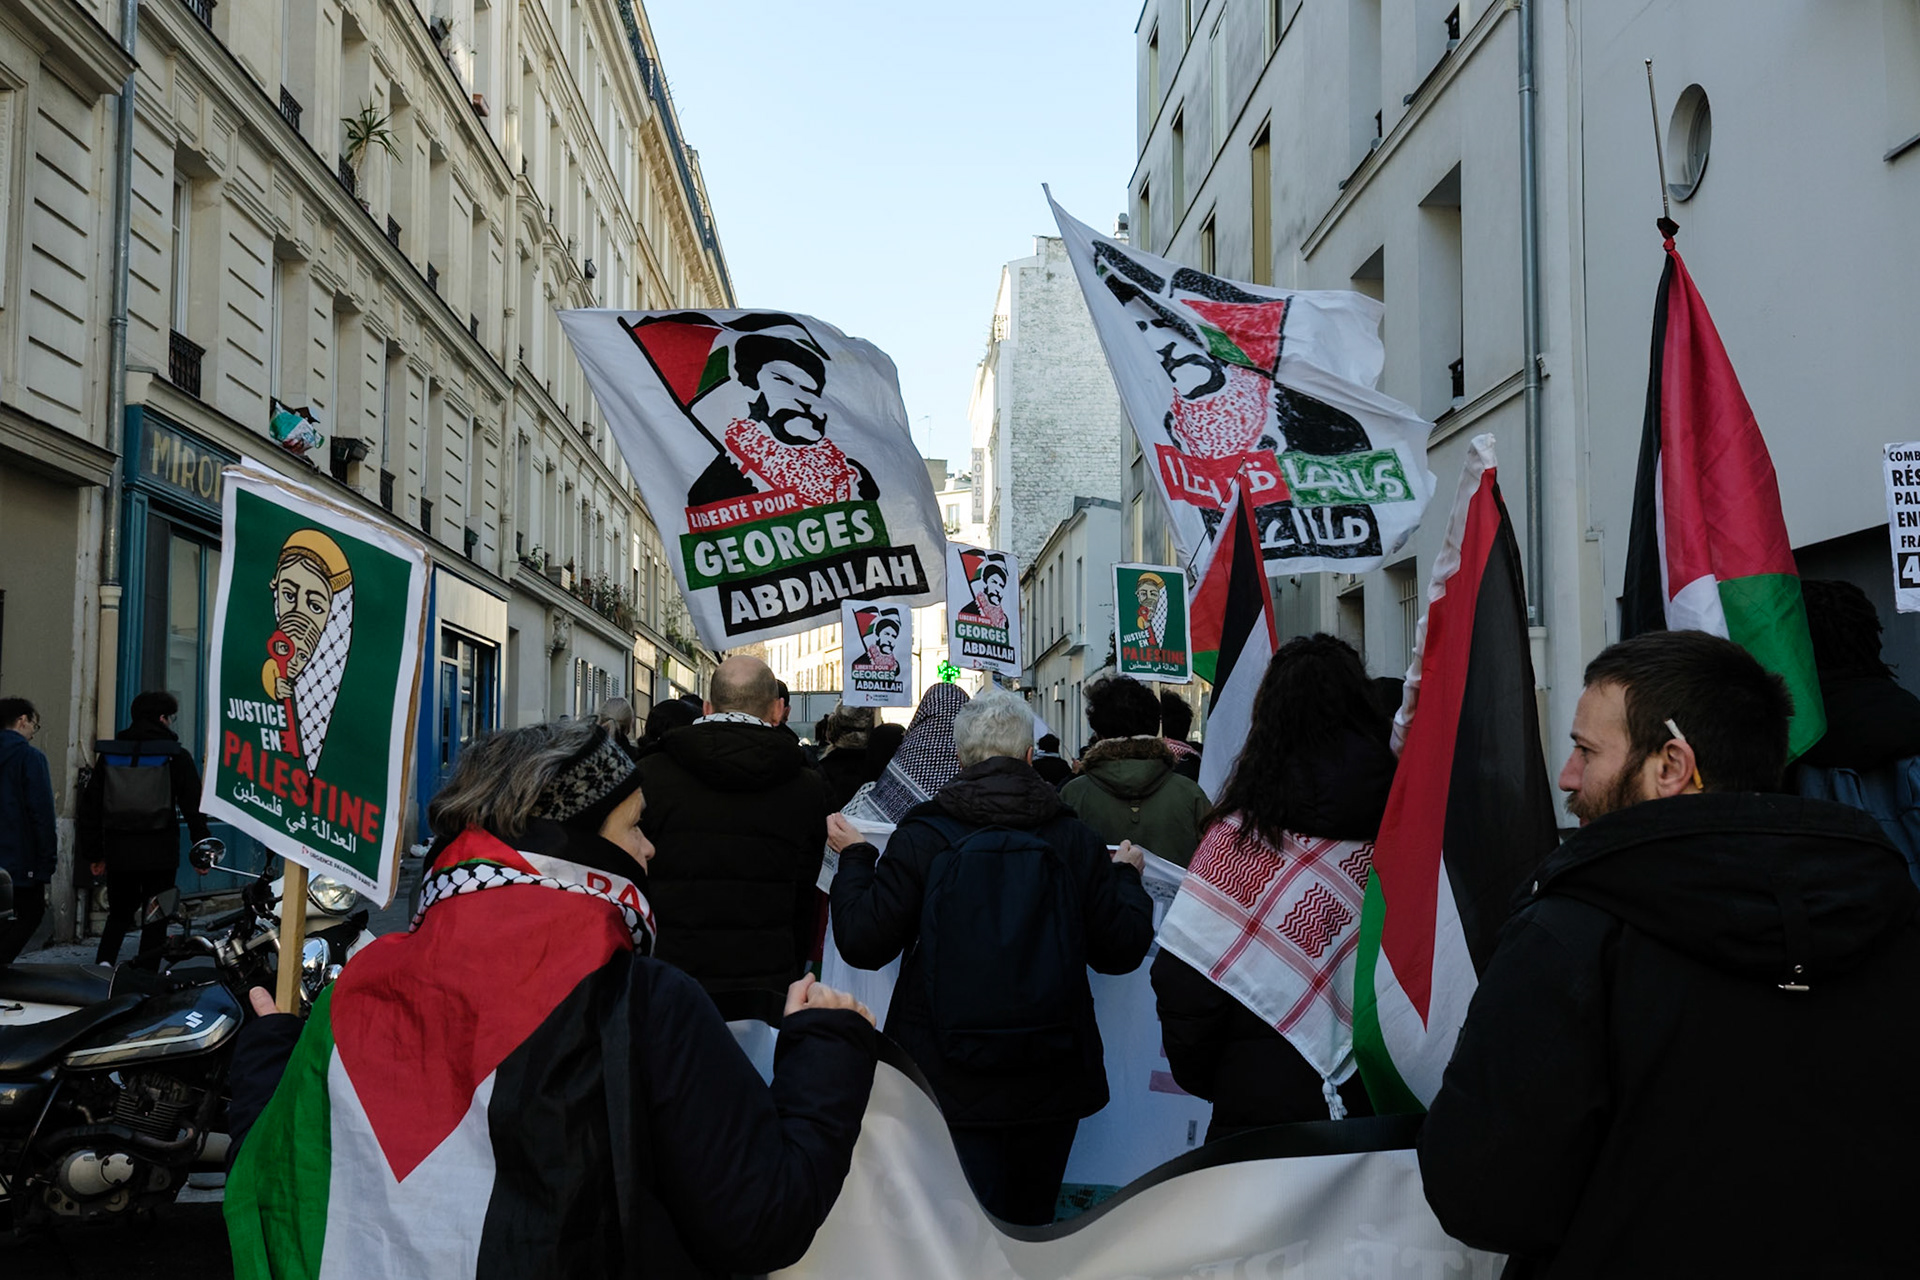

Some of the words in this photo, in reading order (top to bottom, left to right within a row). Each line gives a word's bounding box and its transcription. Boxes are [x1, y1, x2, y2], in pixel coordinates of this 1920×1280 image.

[151, 430, 222, 503] MIROI
[974, 451, 982, 509] HOTEL
[690, 500, 749, 529] LIBERTÉ
[752, 493, 798, 515] POUR
[1897, 511, 1920, 528] EN
[694, 509, 875, 577] GEORGES
[731, 554, 918, 625] ABDALLAH
[957, 623, 1007, 644] GEORGES
[1123, 629, 1150, 643] JUSTICE
[1138, 639, 1149, 648] EN
[964, 641, 1014, 661] ABDALLAH
[1122, 646, 1185, 665] PALESTINE
[852, 670, 895, 680] GEORGES
[856, 680, 902, 692] ABDALLAH
[227, 698, 287, 727] JUSTICE
[260, 728, 282, 752] EN
[223, 730, 381, 843] PALESTINE
[233, 781, 283, 817] فلسطين
[286, 811, 308, 833] في
[311, 815, 357, 853] العدالة
